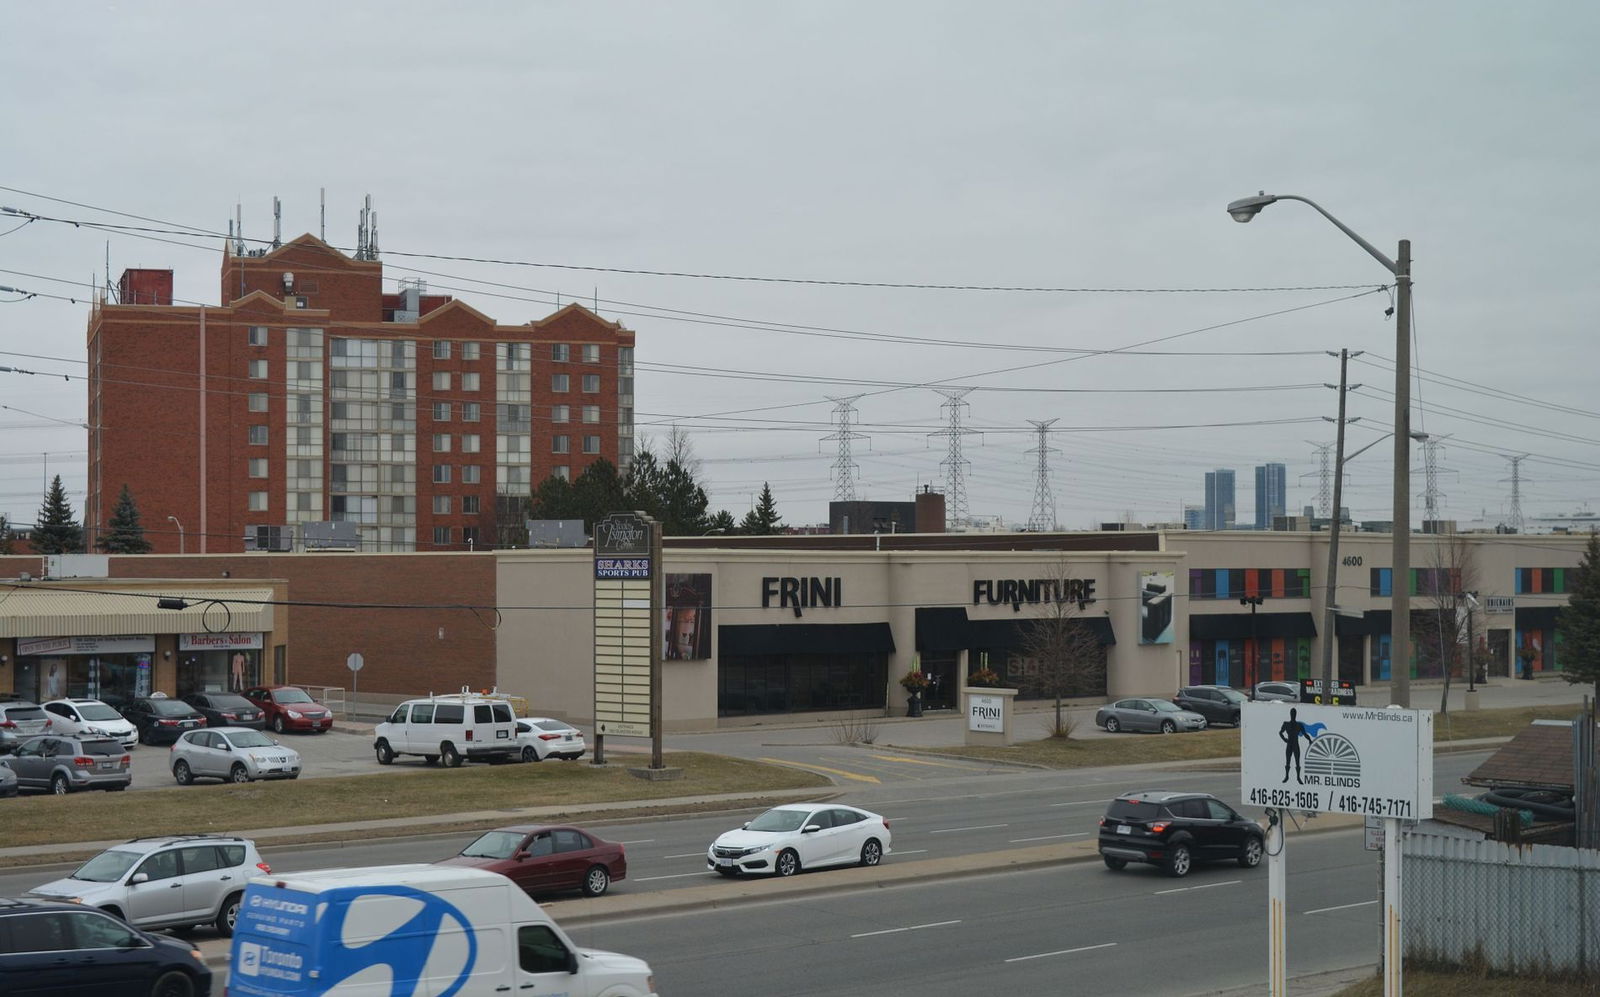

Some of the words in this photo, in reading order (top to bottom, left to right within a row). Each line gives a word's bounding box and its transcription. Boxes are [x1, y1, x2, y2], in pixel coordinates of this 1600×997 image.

[597, 560, 649, 570] SHARKS
[598, 569, 629, 577] SPORTS
[762, 577, 842, 618] FRINI
[974, 578, 1097, 612] FURNITURE
[191, 636, 224, 646] Barbers
[228, 634, 252, 645] Salon
[972, 706, 1000, 719] FRINI
[1342, 711, 1413, 723] www.MrBlinds.ca
[1304, 775, 1322, 786] MR.
[1324, 776, 1361, 788] BLINDS
[1250, 787, 1319, 810] 416-625-1505
[1339, 795, 1411, 818] 416-745-7171
